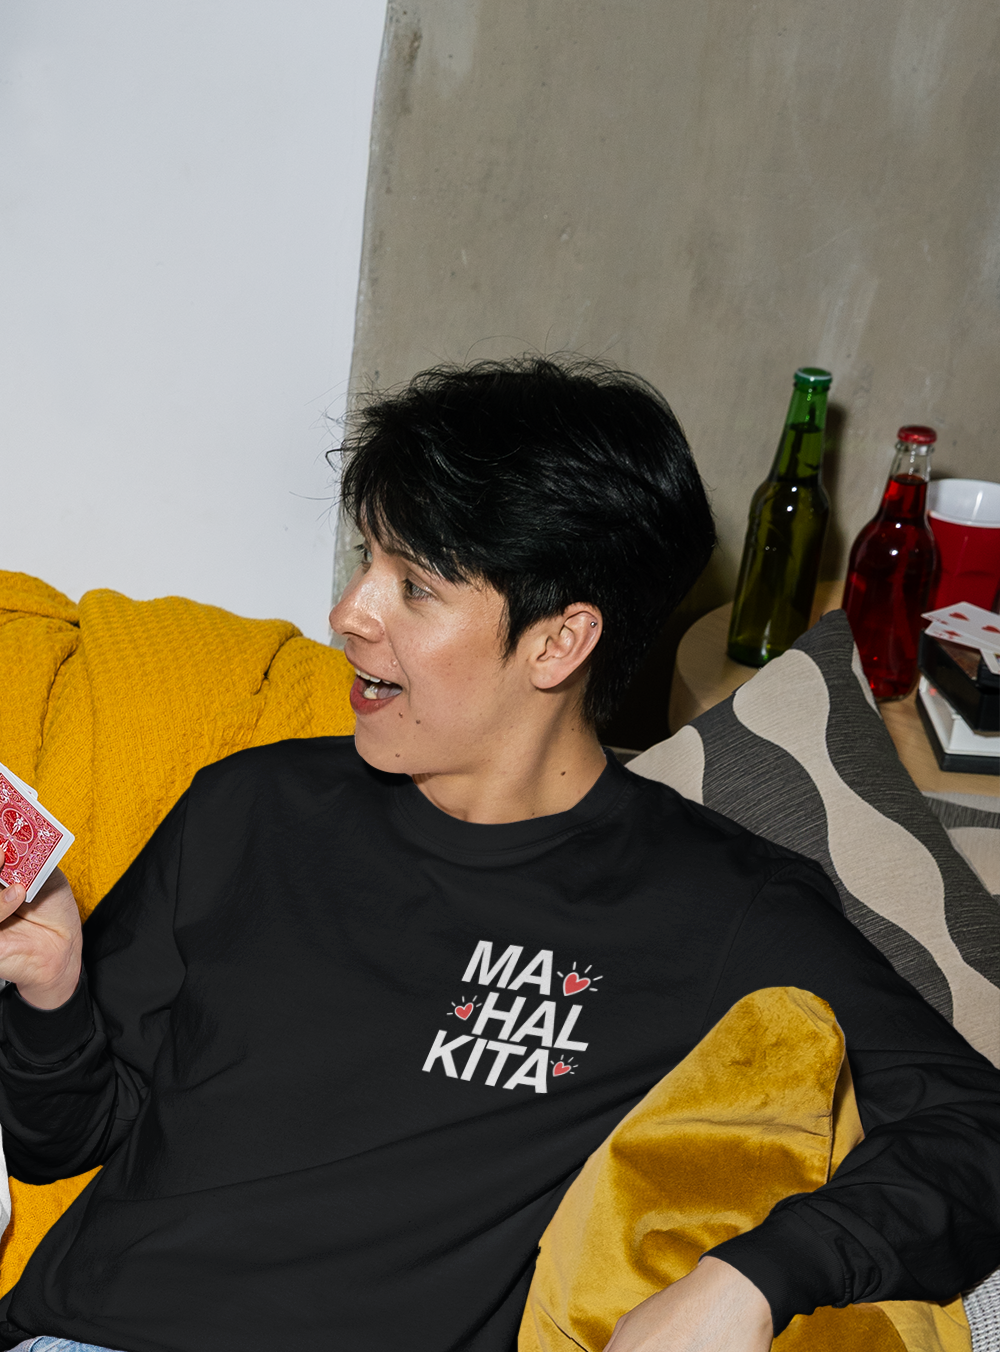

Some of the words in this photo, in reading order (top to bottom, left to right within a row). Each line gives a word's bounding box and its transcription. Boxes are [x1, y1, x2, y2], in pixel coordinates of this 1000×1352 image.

[461, 939, 554, 996] MA
[471, 991, 589, 1052] HAL
[421, 1029, 550, 1094] KITA
